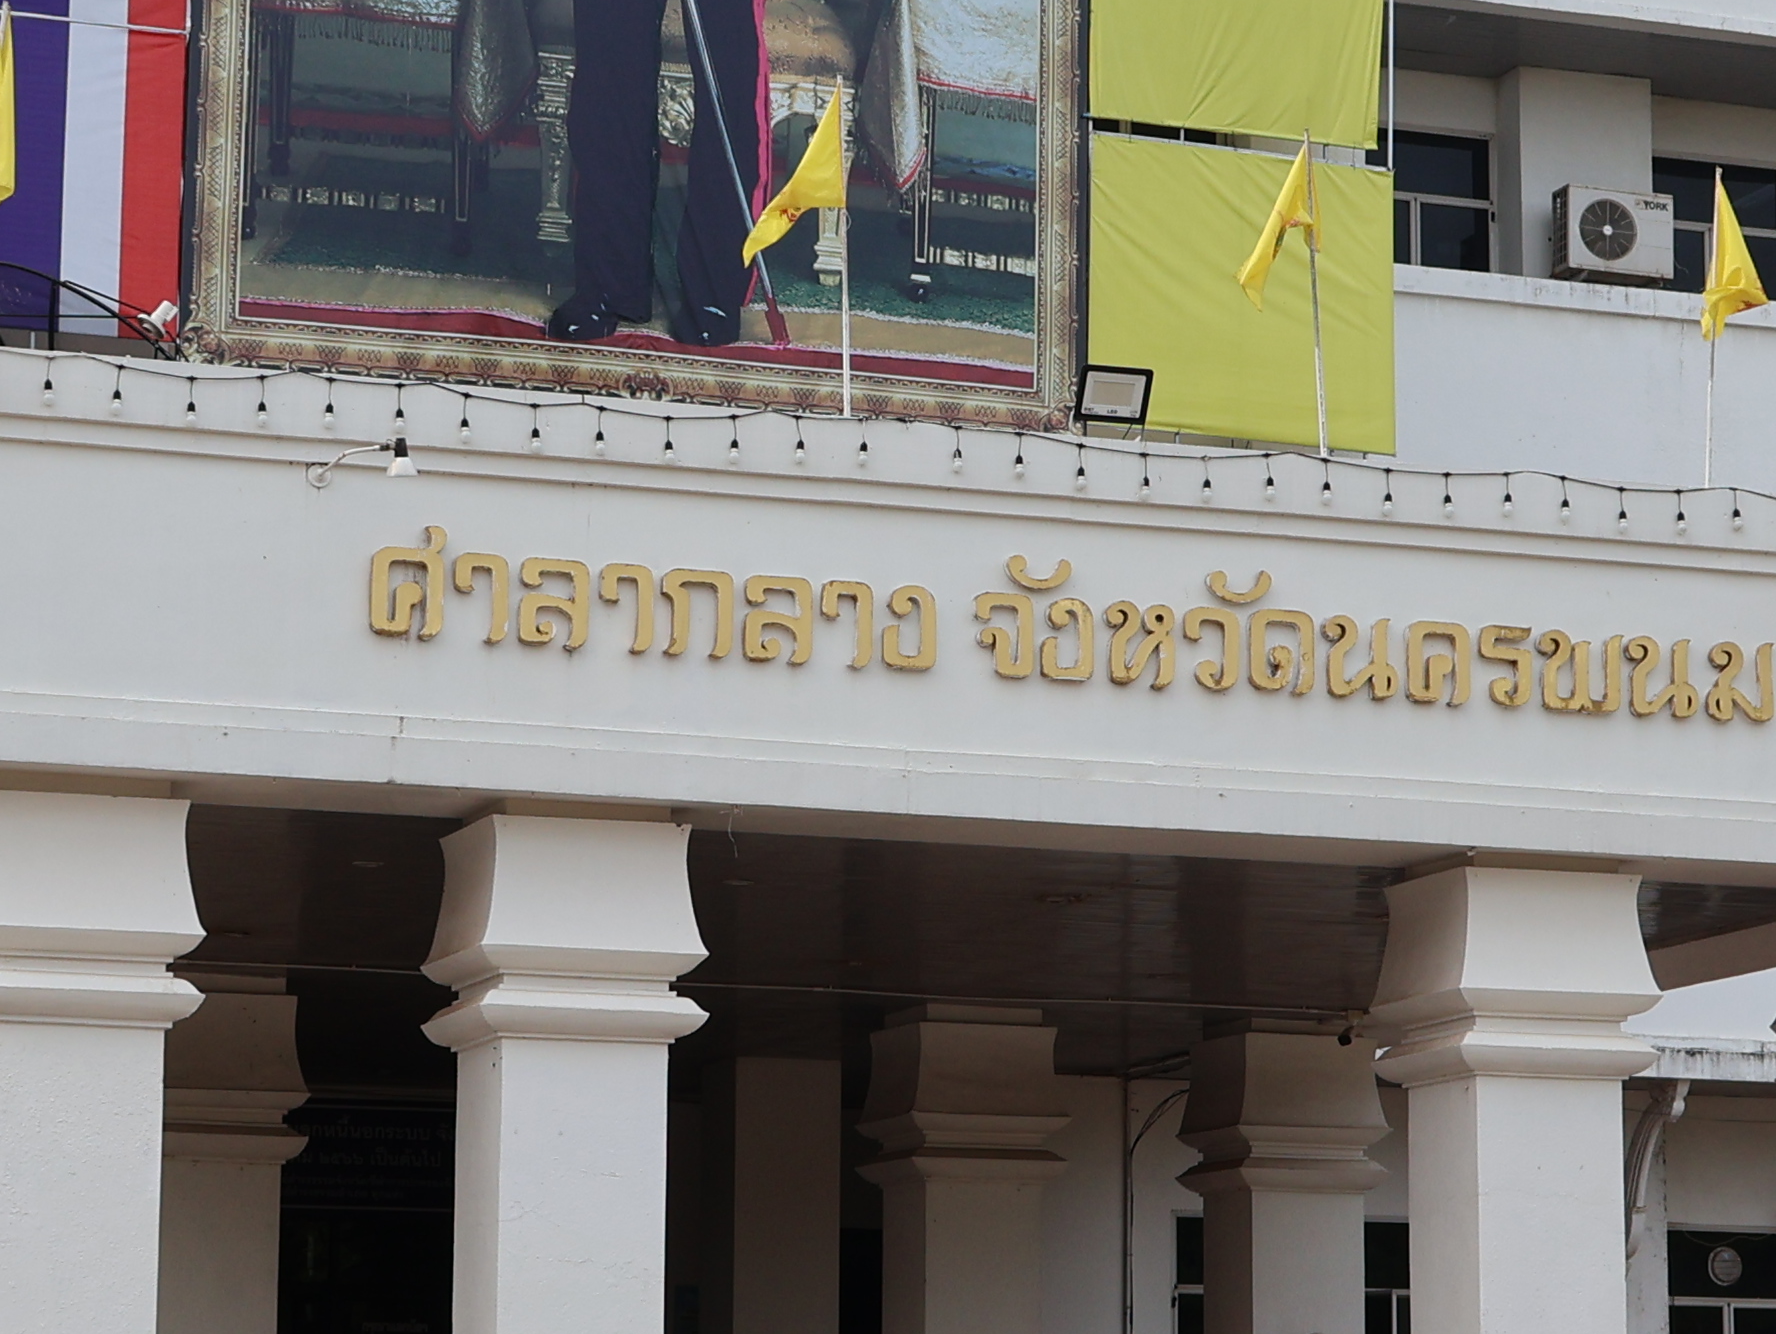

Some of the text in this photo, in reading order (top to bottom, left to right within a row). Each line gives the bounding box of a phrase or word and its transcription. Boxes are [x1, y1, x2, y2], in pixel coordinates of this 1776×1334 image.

[368, 526, 1774, 723] ศาลากลาง จังหวัดนครพนม
